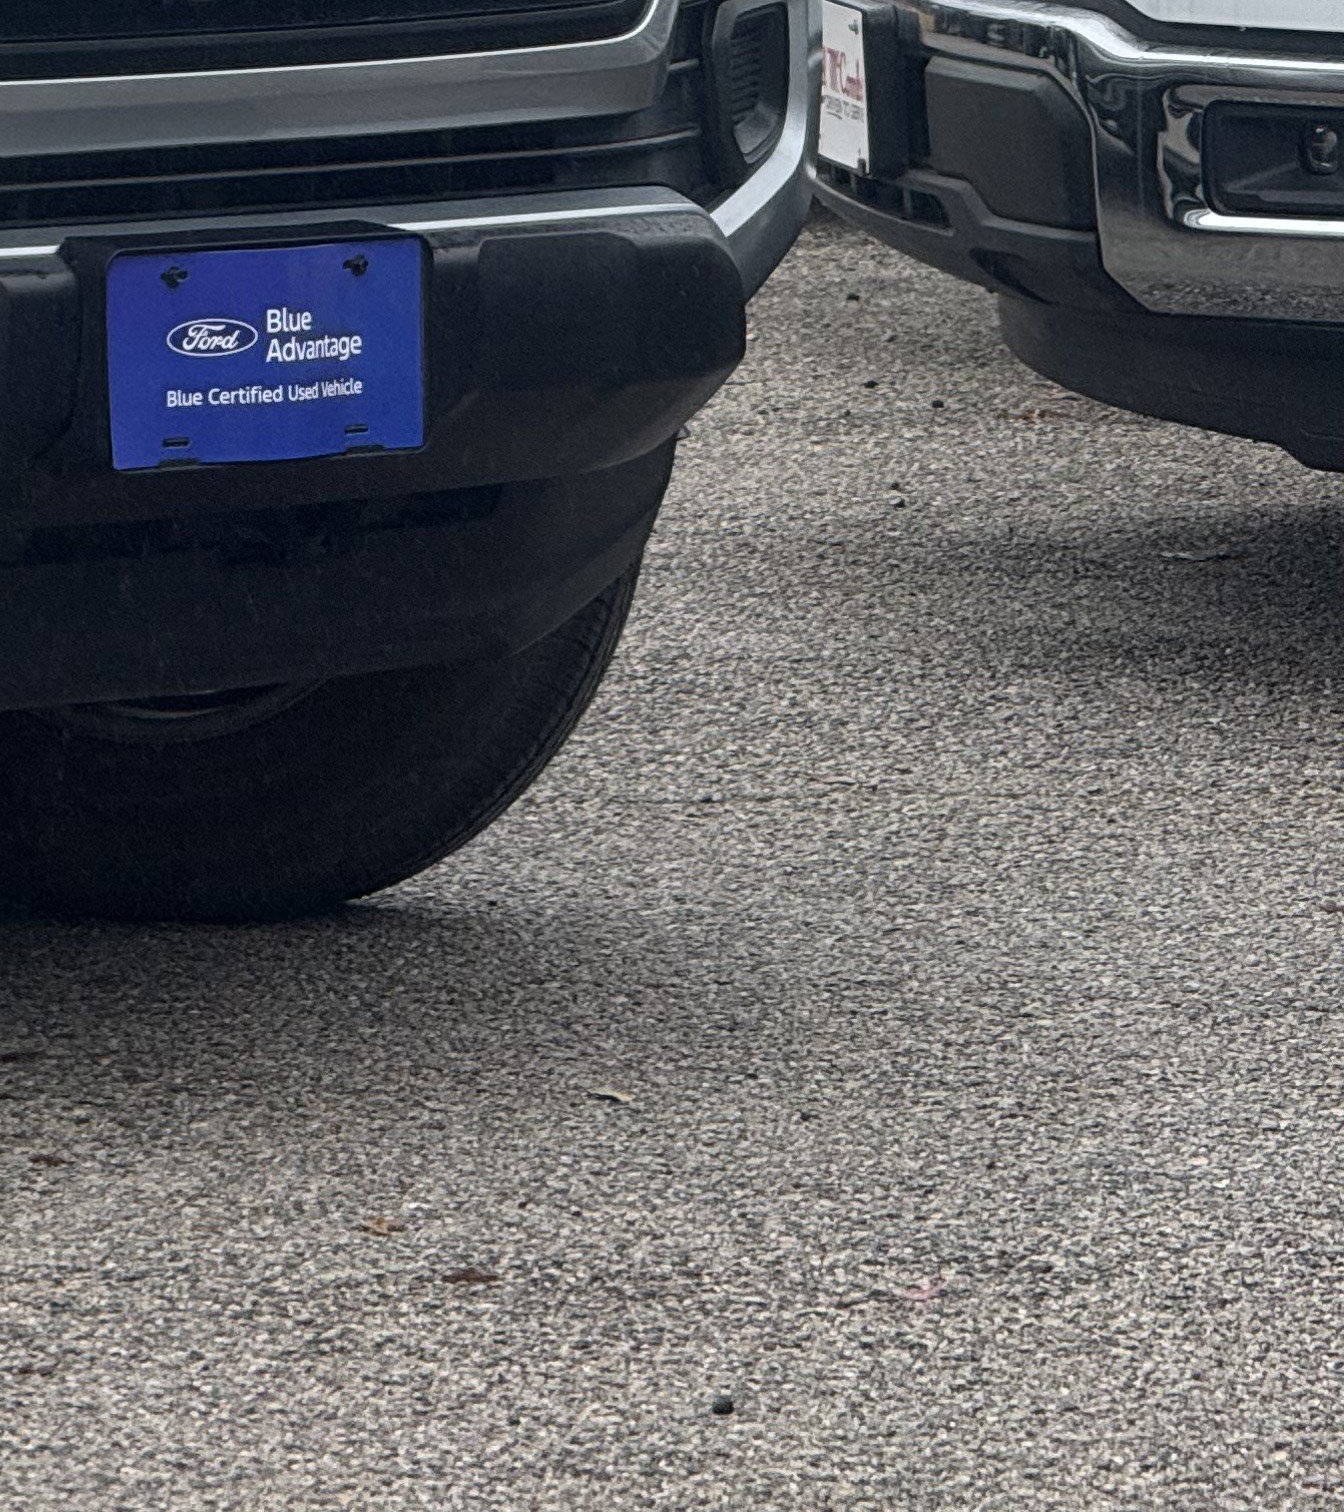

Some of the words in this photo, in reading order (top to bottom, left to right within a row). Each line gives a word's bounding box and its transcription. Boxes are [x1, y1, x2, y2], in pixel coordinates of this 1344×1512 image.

[266, 308, 312, 333] Blue
[182, 323, 239, 351] Ford
[265, 334, 362, 363] Advantage
[166, 389, 203, 408] Blue
[207, 384, 283, 406] Certified
[287, 382, 318, 402] Used
[320, 377, 363, 398] Vehicle
